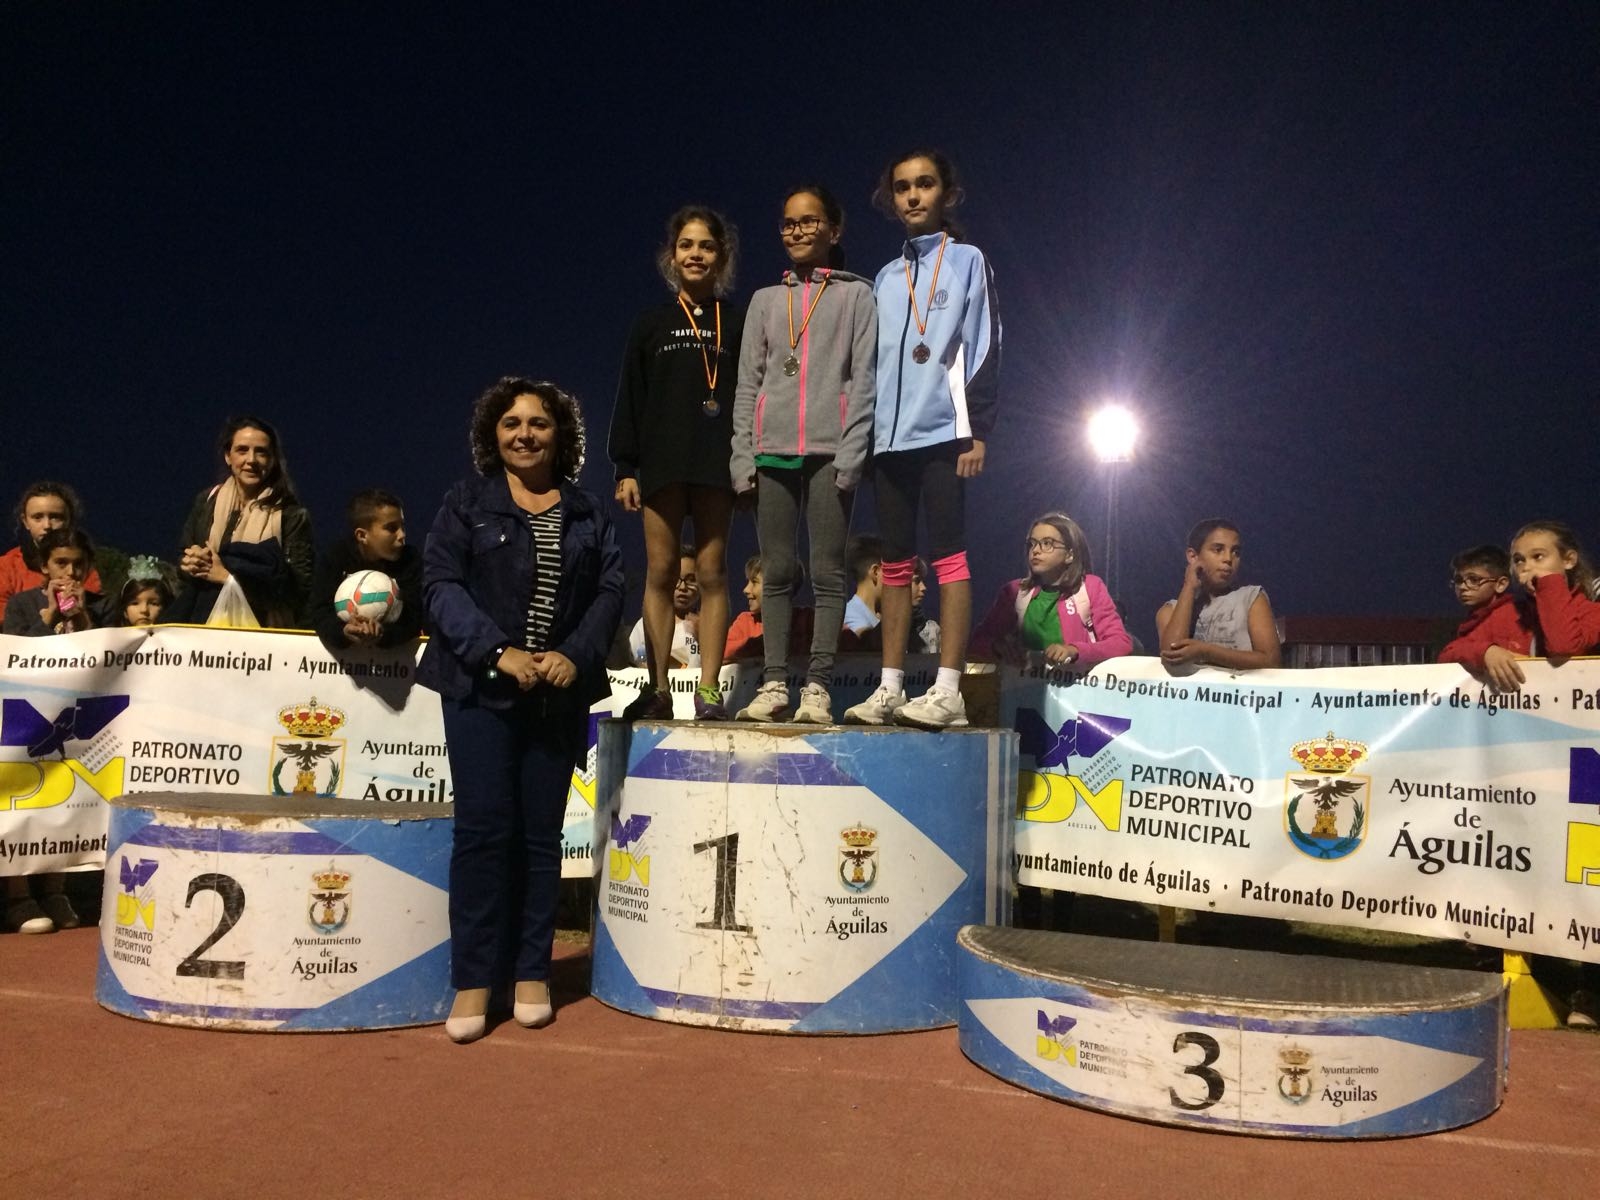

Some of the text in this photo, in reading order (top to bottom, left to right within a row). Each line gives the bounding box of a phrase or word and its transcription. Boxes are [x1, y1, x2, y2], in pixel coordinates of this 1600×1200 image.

[7, 649, 409, 679] Patronato Deportivo Municipal Ayuntamiento
[1105, 673, 1189, 700] Deportivo
[1195, 686, 1283, 713] Municipal
[1312, 689, 1442, 714] Ayuntamiento
[1449, 687, 1471, 709] de
[1477, 683, 1541, 716] Águilas
[131, 741, 243, 761] PATRONATO
[361, 739, 447, 760] Ayuntami
[129, 765, 241, 786] DEPORTIVO
[413, 761, 434, 779] de
[1131, 764, 1254, 794] PATRONATO
[1388, 778, 1536, 805] Ayuntamiento
[1128, 790, 1252, 821] DEPORTIVO
[1454, 807, 1481, 829] de
[1127, 817, 1250, 849] MUNICIPAL
[0, 833, 107, 863] Ayuntamient
[1388, 822, 1532, 875] Águilas
[609, 882, 649, 897] PATRONATO
[694, 832, 753, 932] 1
[609, 894, 649, 910] DEPORTIVO
[825, 894, 890, 907] Ayuntamiento
[1016, 853, 1113, 880] yuntamiento
[1119, 862, 1138, 884] de
[1144, 860, 1211, 894] Águilas
[1241, 879, 1334, 908] Patronato
[1341, 890, 1437, 918] Deportivo
[1444, 901, 1535, 938] Municipal
[608, 906, 648, 923] MUNICIPAL
[852, 907, 864, 917] de
[115, 926, 154, 942] PATRONATO
[176, 873, 246, 980] 2
[826, 916, 888, 940] Águilas
[114, 937, 153, 954] DEPORTIVO
[292, 936, 362, 949] Ayuntamiento
[320, 948, 332, 958] de
[113, 950, 151, 967] MUNICIPAL
[291, 955, 358, 980] Águilas
[1169, 1031, 1225, 1111] 3
[1320, 1066, 1380, 1078] Ayuntamiento
[1345, 1077, 1356, 1086] de
[1321, 1084, 1378, 1108] Águilas
